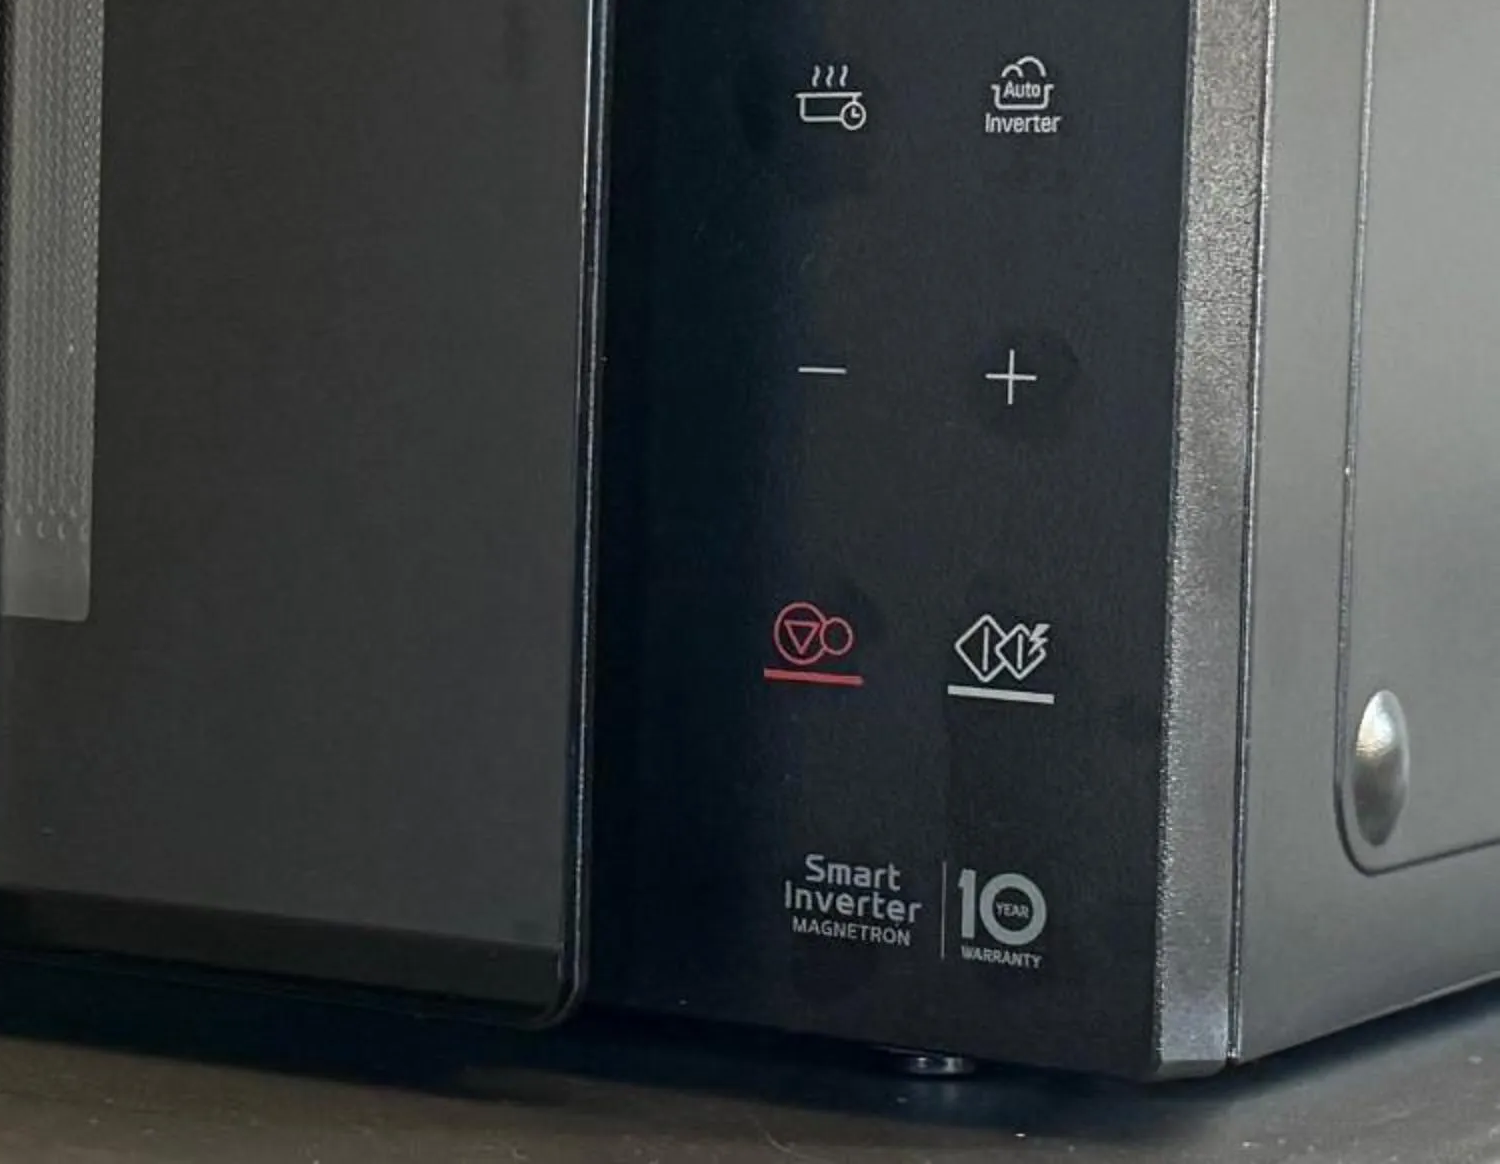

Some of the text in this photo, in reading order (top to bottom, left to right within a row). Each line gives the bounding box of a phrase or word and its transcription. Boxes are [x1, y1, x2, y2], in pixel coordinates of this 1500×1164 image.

[1002, 80, 1042, 99] Auto
[984, 112, 1063, 134] Inverter
[804, 854, 901, 892] Smart
[784, 880, 923, 924] Inverter
[957, 868, 1047, 946] 10
[996, 902, 1030, 919] YEAR
[792, 916, 911, 947] MAGNETRON
[961, 945, 1043, 969] WARRANTY
